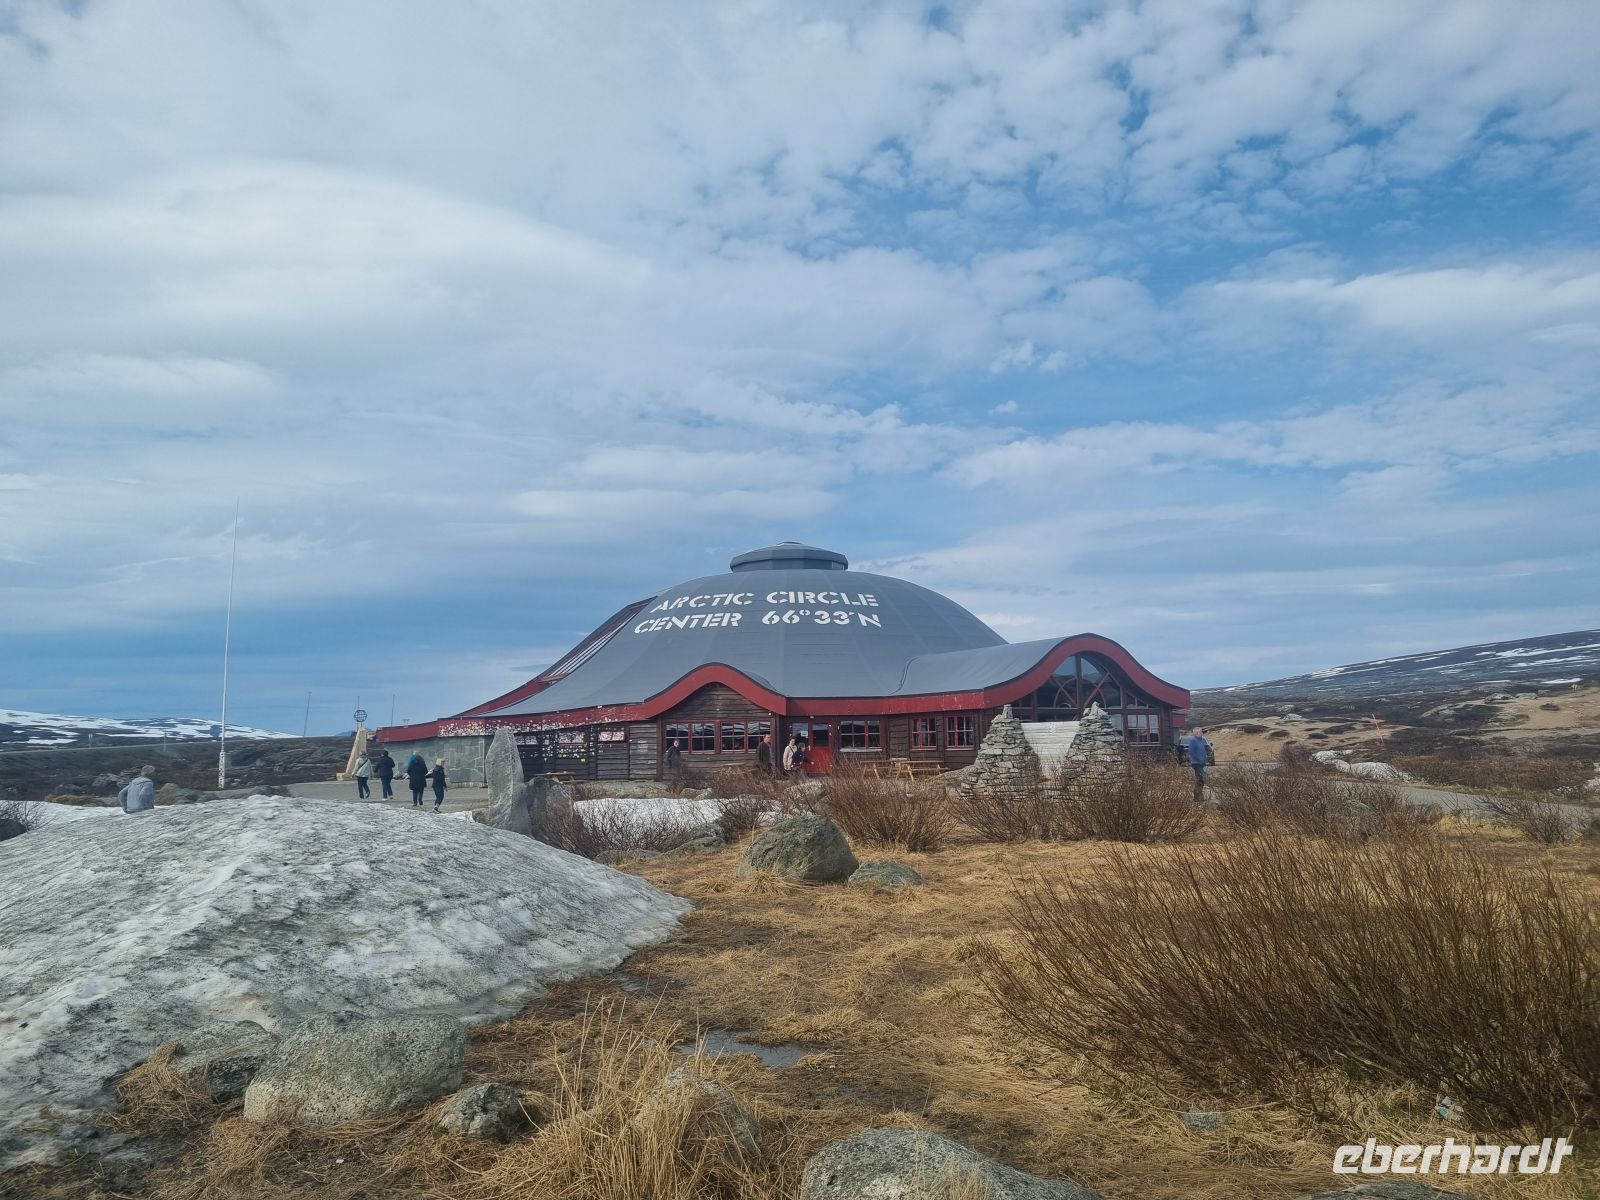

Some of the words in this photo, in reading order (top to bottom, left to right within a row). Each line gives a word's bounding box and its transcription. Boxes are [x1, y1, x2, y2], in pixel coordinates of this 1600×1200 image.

[651, 592, 754, 612] ARCTIC
[766, 591, 879, 607] CIRCLE
[634, 613, 742, 634] CENTER
